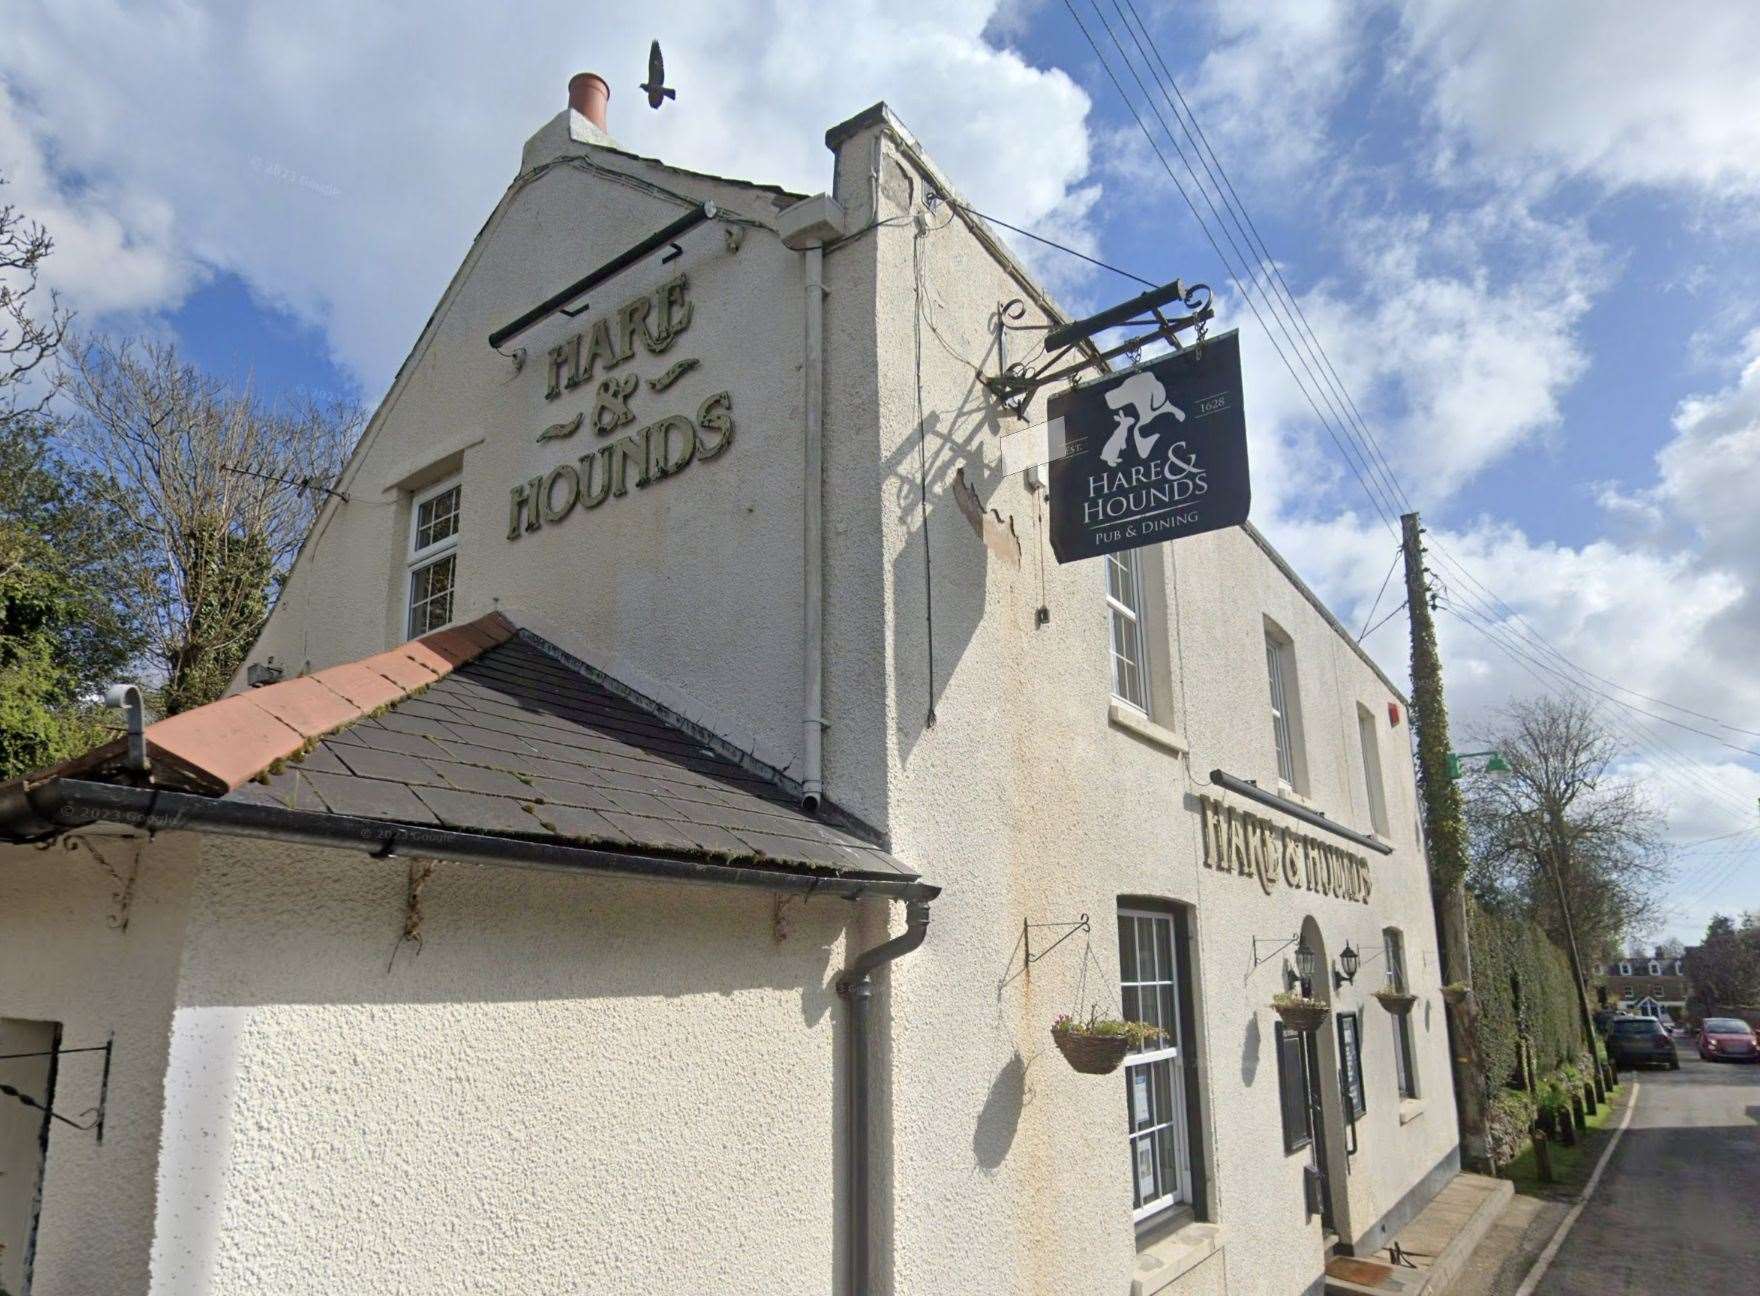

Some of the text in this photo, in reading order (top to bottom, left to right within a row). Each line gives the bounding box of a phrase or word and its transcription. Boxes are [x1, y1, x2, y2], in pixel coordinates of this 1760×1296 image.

[545, 272, 695, 401] HARE
[591, 373, 639, 437] &
[1201, 397, 1225, 413] 1628
[506, 391, 736, 541] HOUNDS
[1083, 473, 1208, 524] HOUNDS
[1095, 511, 1199, 545] PUB & DINING
